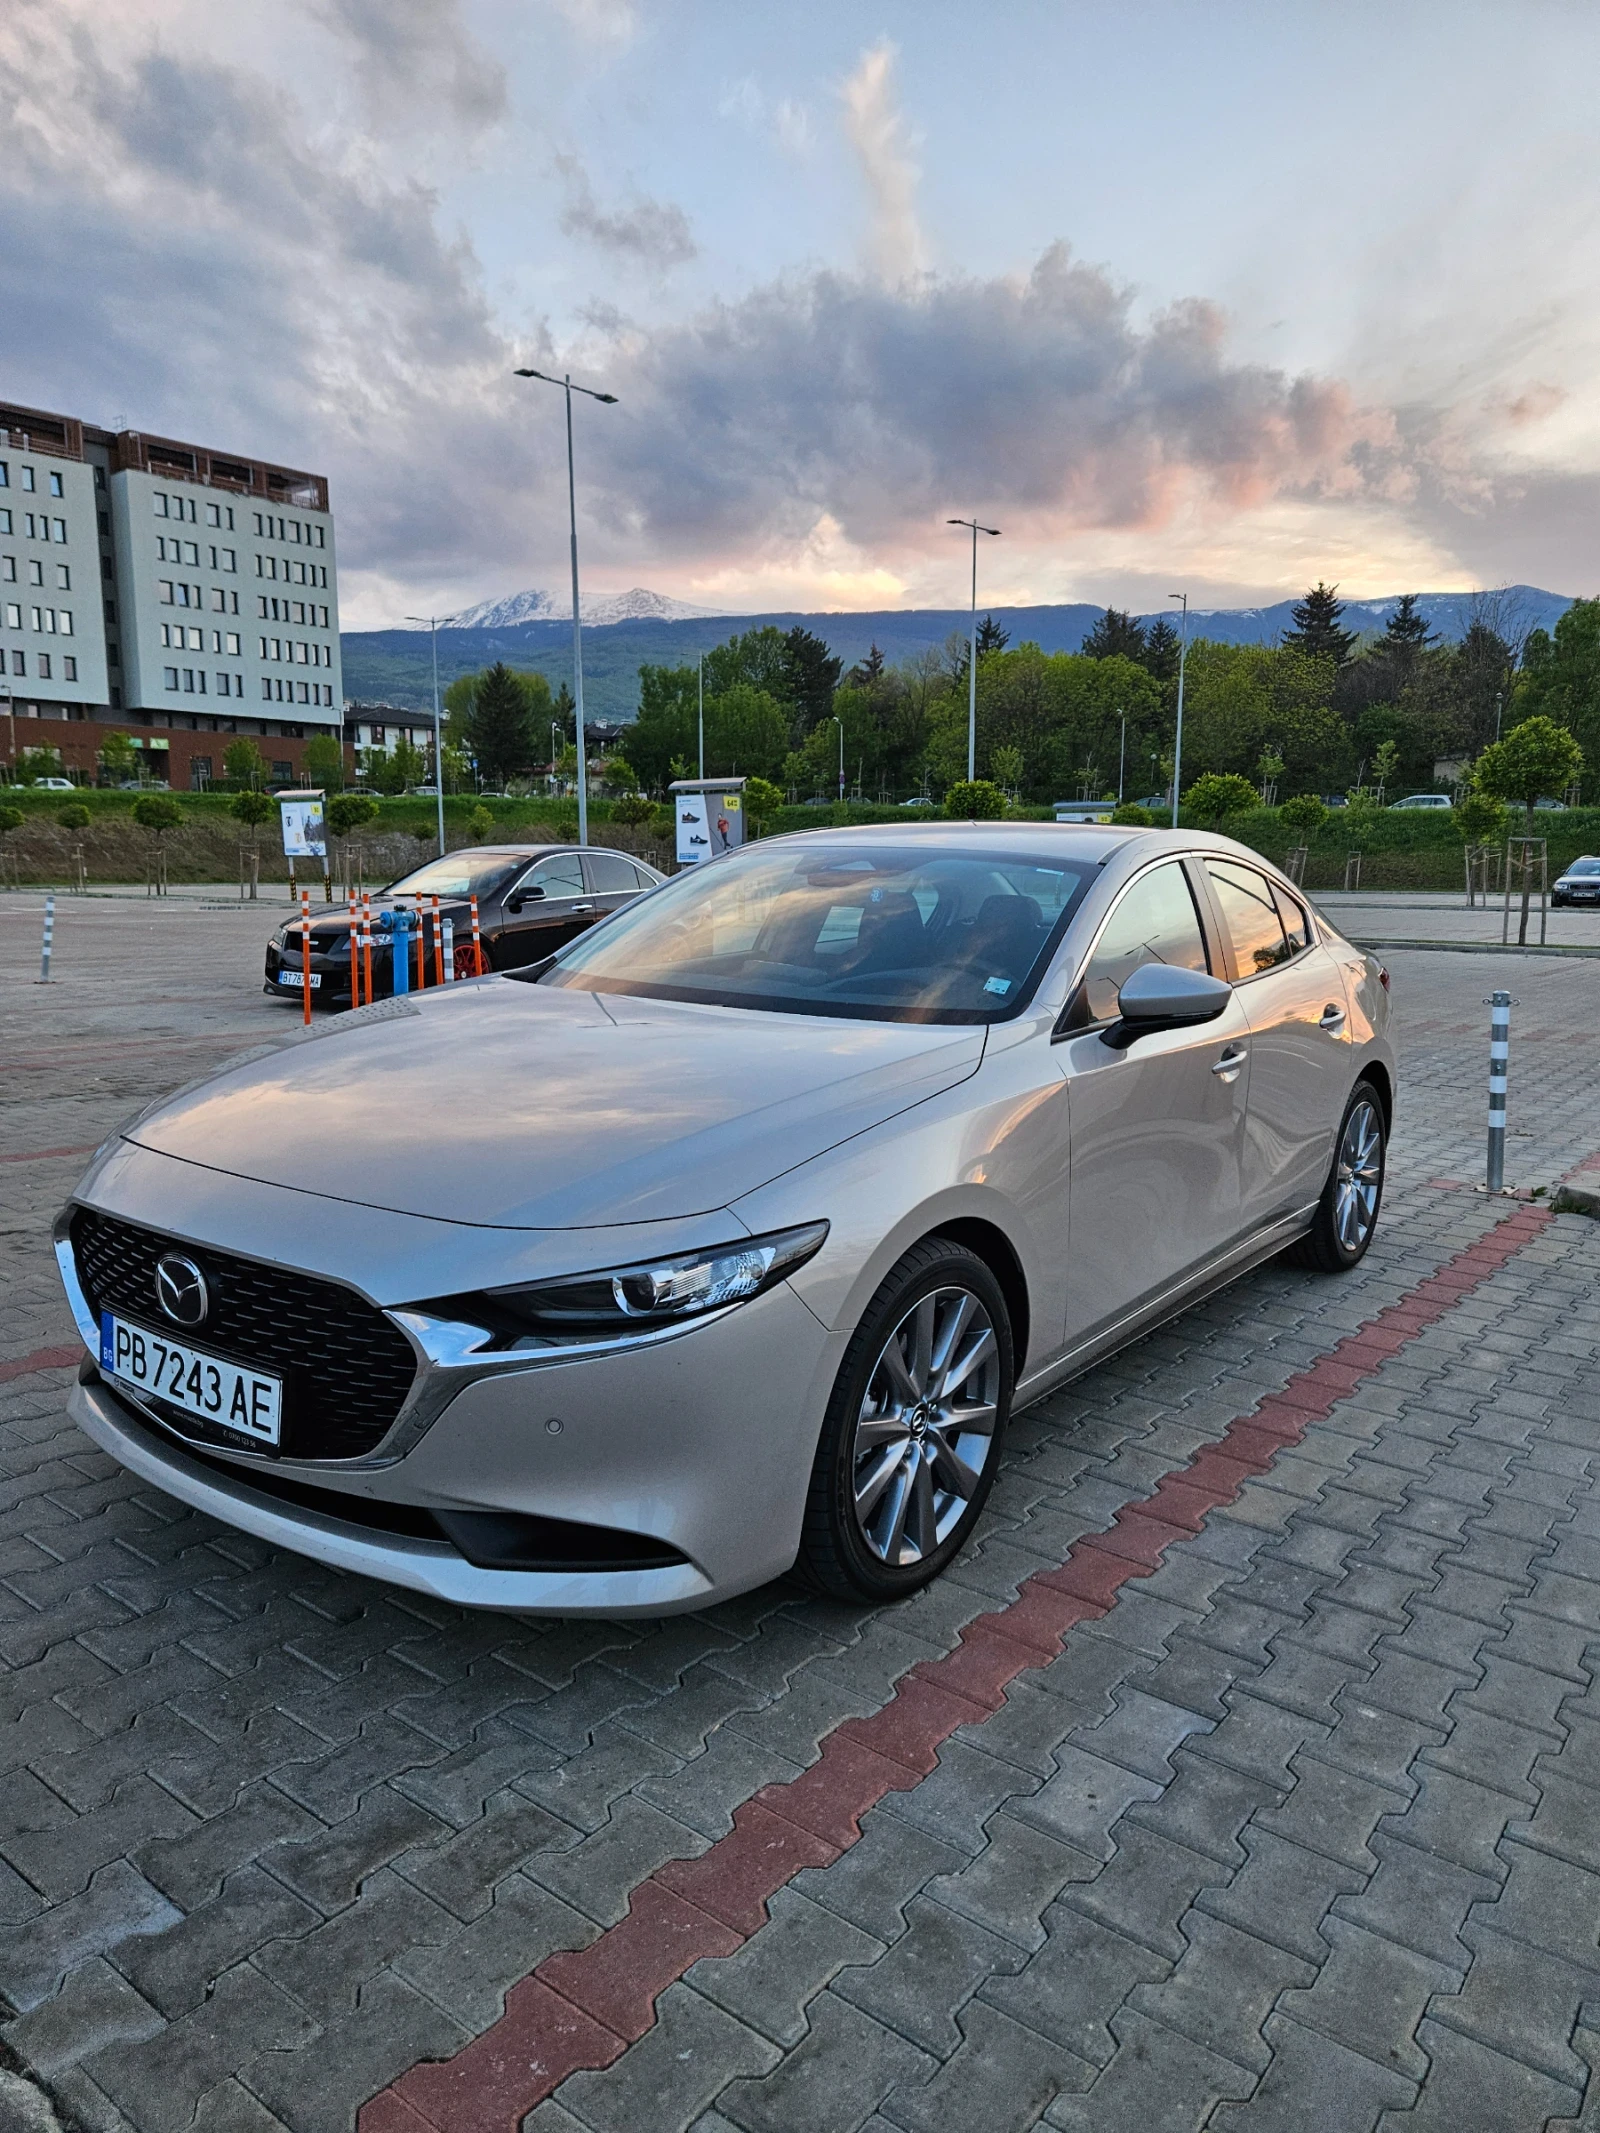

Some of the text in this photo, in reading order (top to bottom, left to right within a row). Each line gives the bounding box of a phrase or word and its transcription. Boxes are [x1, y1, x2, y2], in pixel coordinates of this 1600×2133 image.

[103, 1346, 113, 1362] BG
[116, 1325, 272, 1434] PB 7243 AE
